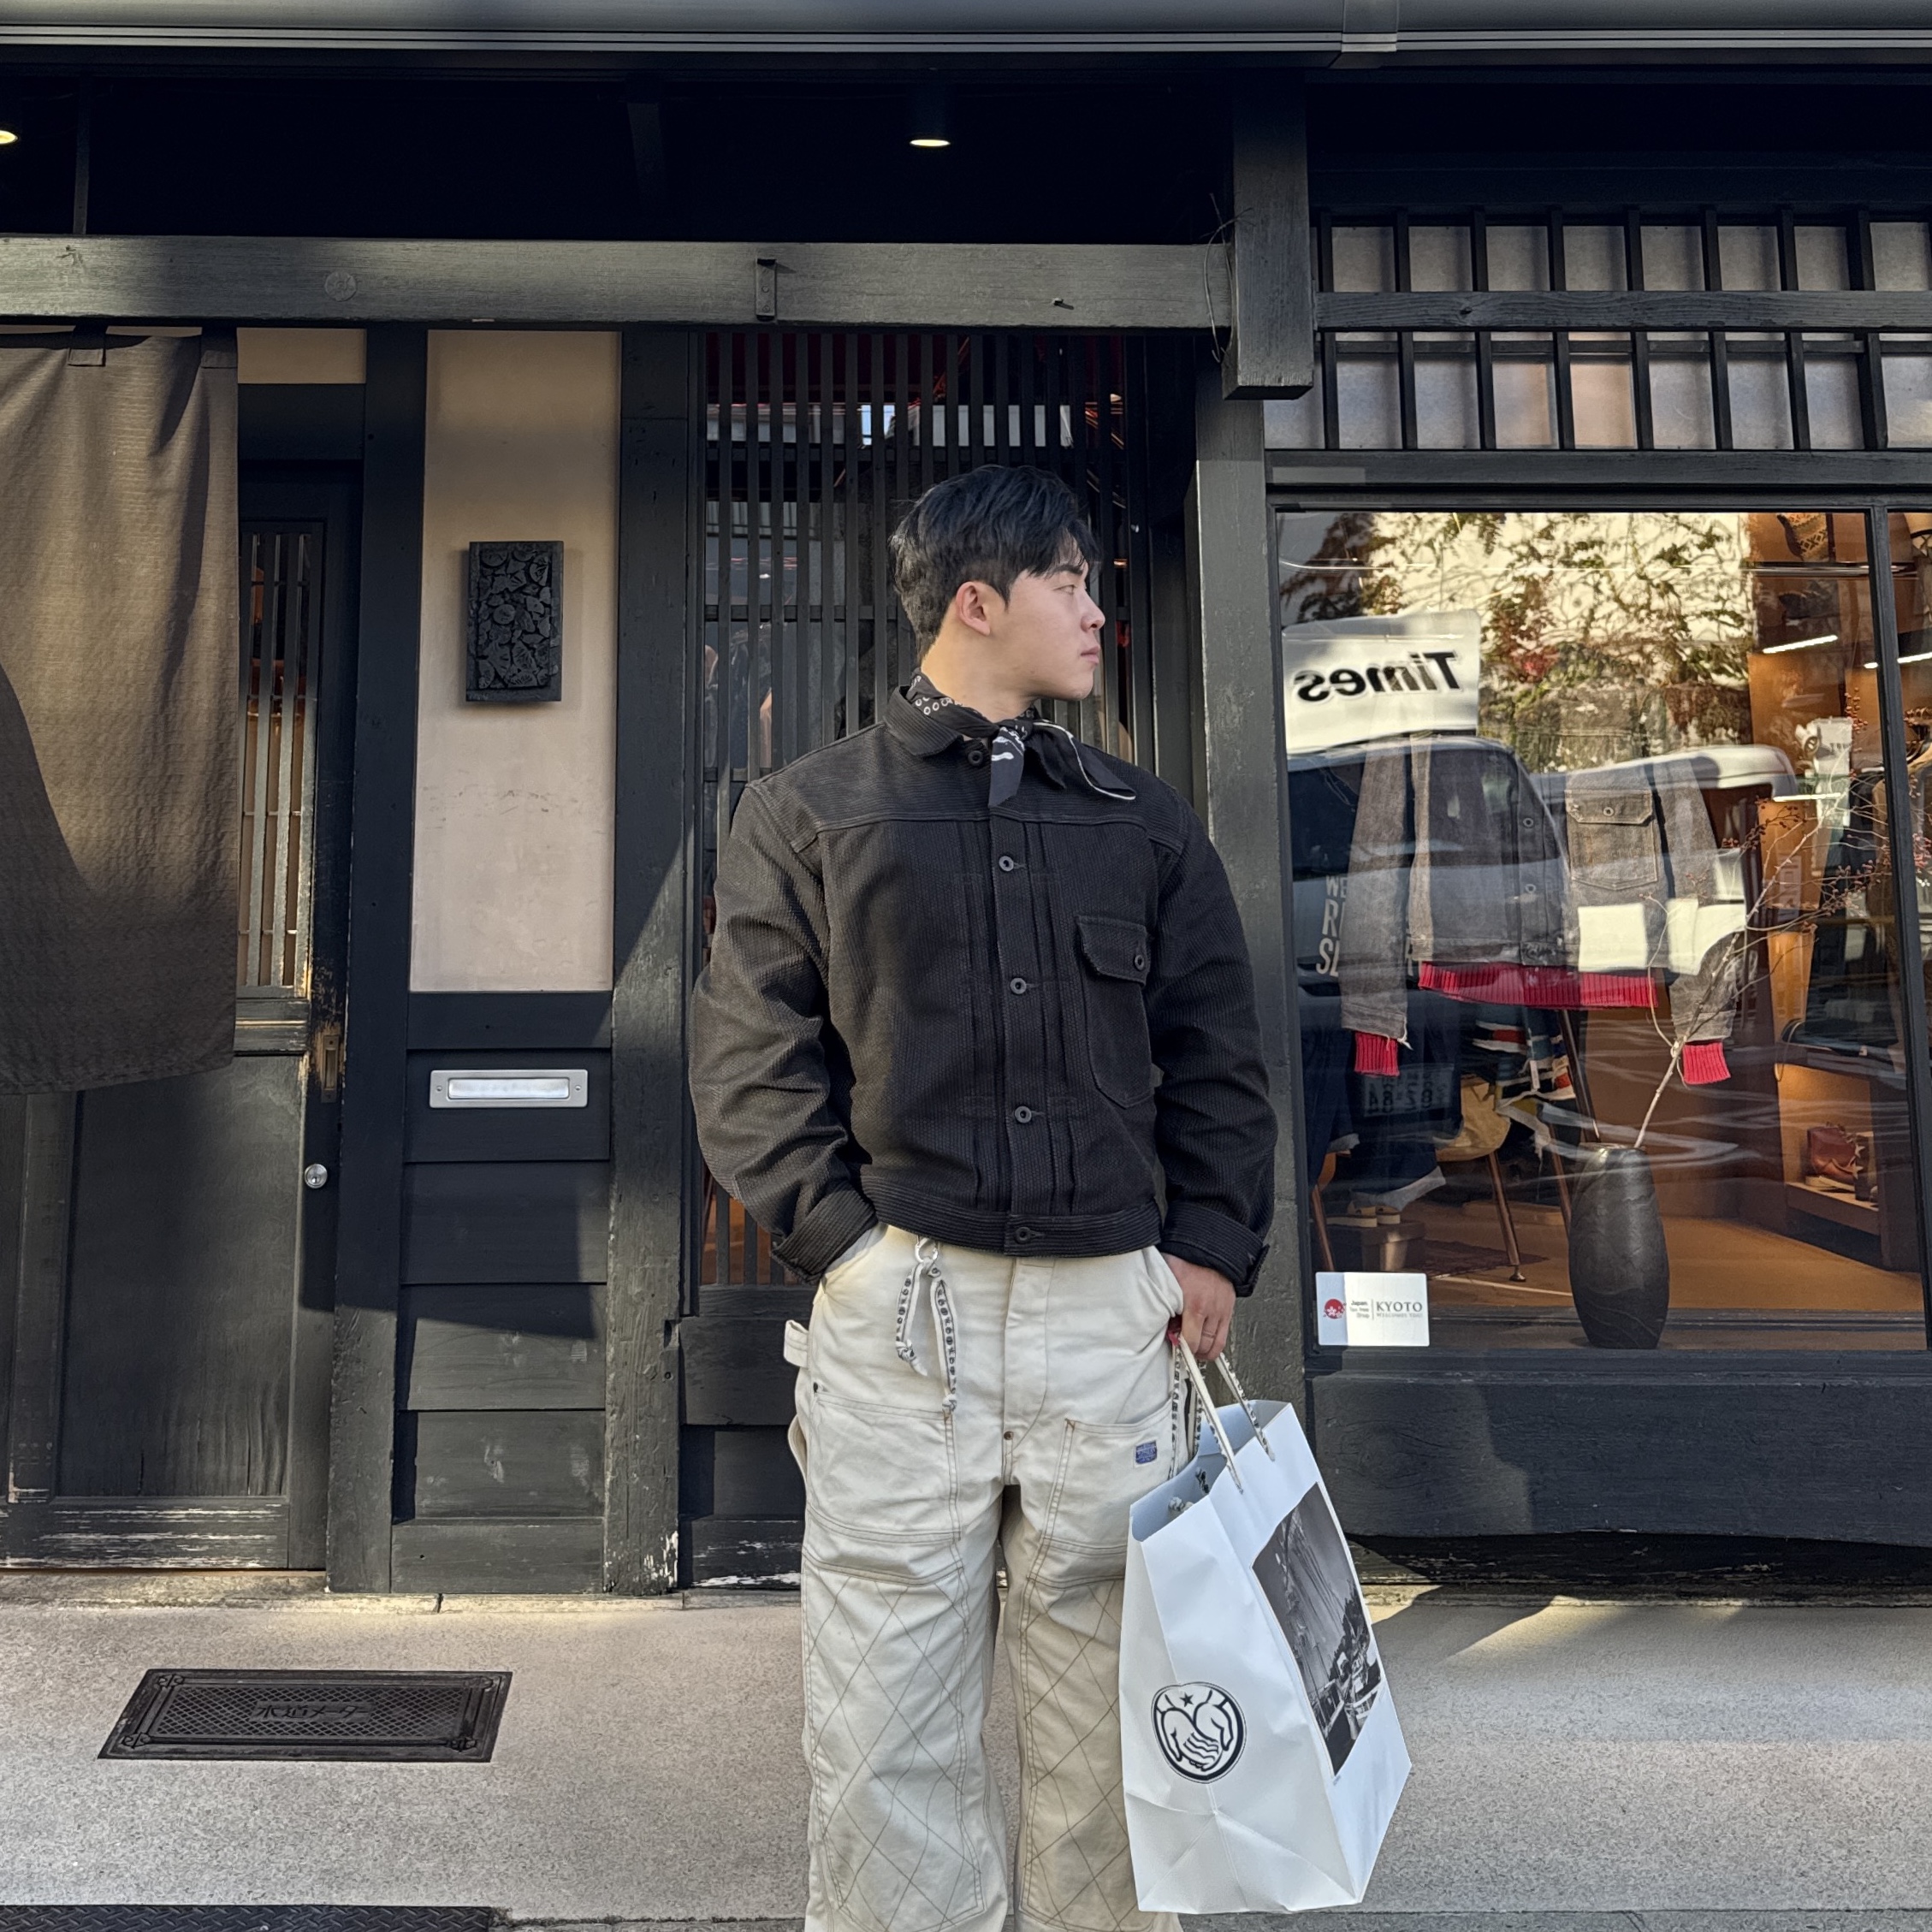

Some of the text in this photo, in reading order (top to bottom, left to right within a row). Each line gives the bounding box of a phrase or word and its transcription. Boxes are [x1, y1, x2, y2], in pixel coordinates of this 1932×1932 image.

[1376, 1301, 1423, 1312] KYOTO
[255, 1704, 370, 1719] 水道メーター
